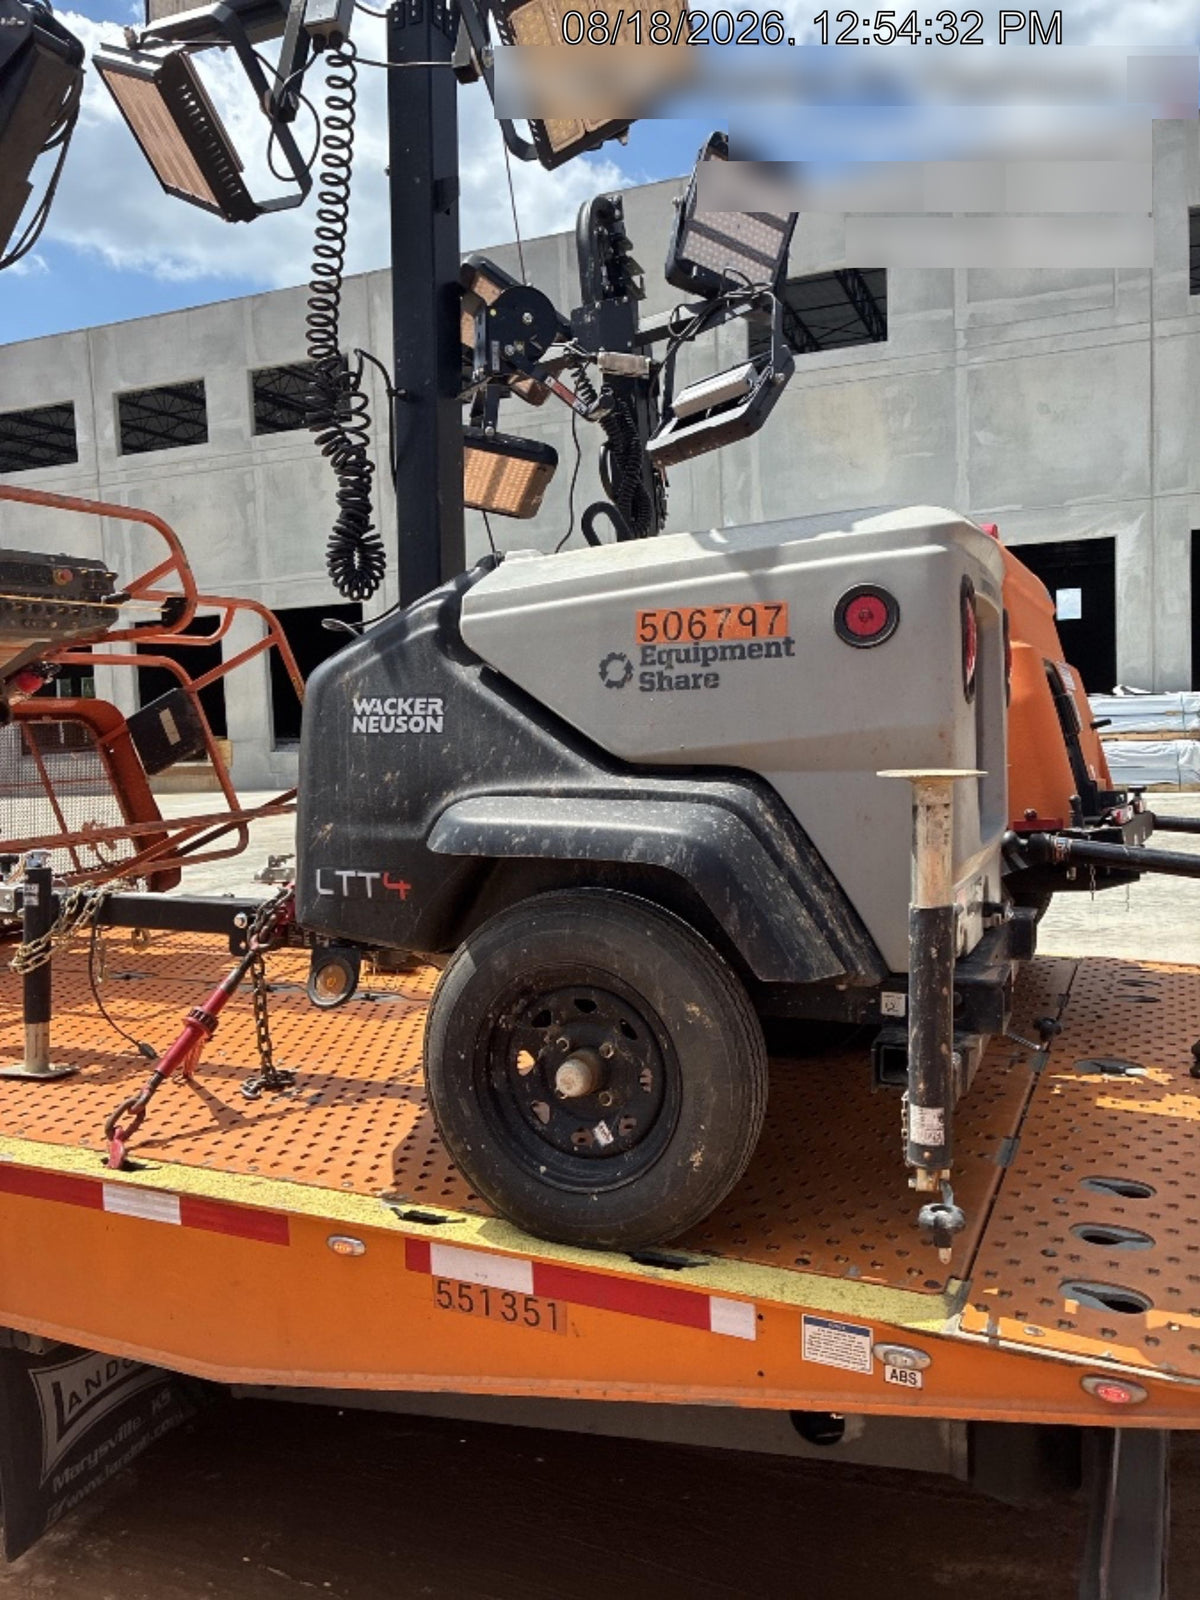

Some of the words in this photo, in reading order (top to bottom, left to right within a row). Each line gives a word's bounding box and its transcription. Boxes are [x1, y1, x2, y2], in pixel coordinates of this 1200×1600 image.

[639, 605, 783, 642] 506797
[639, 636, 796, 669] Equipment
[639, 670, 720, 692] Share
[352, 697, 444, 715] WACKER
[352, 716, 444, 733] NEUSON
[316, 869, 411, 900] LTT4
[436, 1280, 557, 1331] 551351
[890, 1369, 917, 1385] ABS
